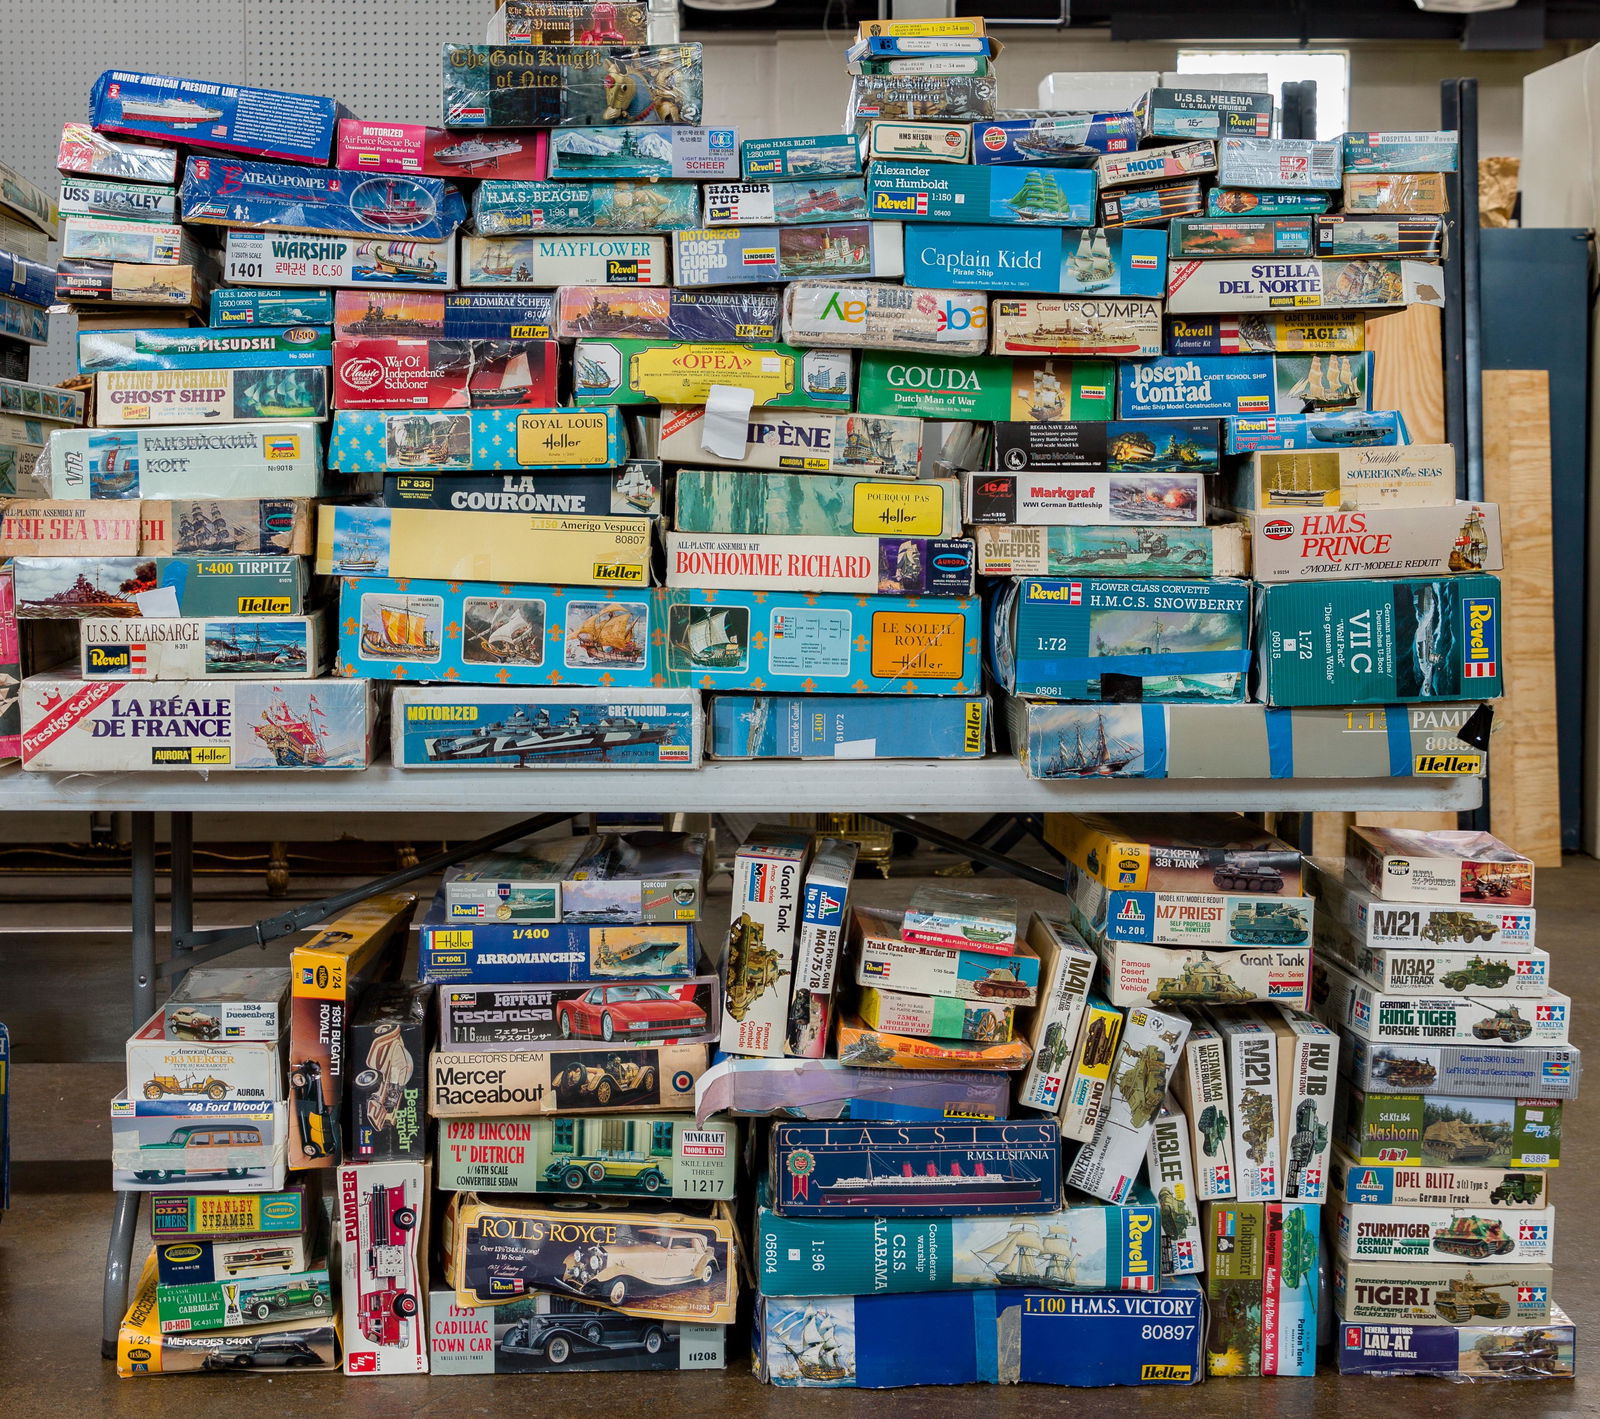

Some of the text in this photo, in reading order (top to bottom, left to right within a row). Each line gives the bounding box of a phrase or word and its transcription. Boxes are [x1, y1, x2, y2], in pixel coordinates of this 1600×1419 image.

[449, 49, 601, 69] The Gold Knight
[112, 72, 238, 98] NAVIRE AMERICAN PRESIDENT LINE
[1175, 94, 1252, 106] U.S.S. HELENA
[342, 136, 421, 147] Air Force Rescue Boat
[875, 165, 930, 177] Alexander
[709, 184, 770, 195] HARBOR
[875, 178, 949, 191] von Humboldt
[63, 188, 162, 209] USS BUCKLEY
[709, 195, 740, 205] TUG
[680, 230, 740, 241] MOTORIZED
[272, 241, 347, 260] WARSHIP
[539, 242, 650, 257] MAYFLOWER
[680, 241, 724, 255] COAST
[681, 255, 728, 269] GUARD
[921, 247, 1042, 272] Captain Kidd
[230, 263, 262, 277] 1401
[682, 270, 709, 284] TUG
[1251, 265, 1319, 279] STELLA
[66, 277, 101, 286] Repulse
[1219, 279, 1321, 294] DEL NORTE
[1082, 303, 1158, 318] OLYMPIA
[290, 329, 314, 340] 1/500
[385, 356, 419, 367] War Of
[107, 371, 228, 389] FLYING DUTCHMAN
[385, 368, 444, 378] Independence
[887, 365, 981, 389] GOUDA
[1132, 363, 1201, 383] Joseph
[385, 379, 428, 389] Schooner
[110, 390, 226, 404] GHOST SHIP
[894, 394, 976, 405] Dutch Man of War
[1135, 383, 1212, 402] Conrad
[522, 419, 603, 429] ROYAL LOUIS
[503, 476, 535, 492] LA
[1031, 487, 1095, 498] Markgraf
[451, 492, 585, 512] COURONNE
[1068, 501, 1102, 509] Battleship
[560, 521, 645, 532] Amerigo Vespucci
[615, 536, 645, 544] 80807
[678, 542, 715, 550] ALL-PLASTIC
[238, 561, 291, 574] TIRPITZ
[676, 552, 871, 578] BONHOMME RICHARD
[1091, 583, 1209, 595] FLOWER CLASS CORVETTE
[1091, 596, 1244, 610] H.M.C.S. SNOWBERRY
[86, 622, 200, 642] U.S.S. KEARSARGE
[1038, 638, 1066, 650] 1:72
[1036, 687, 1062, 695] 05061
[112, 695, 231, 717] LA RÉALE
[608, 705, 666, 717] GREYHOUND
[92, 720, 231, 737] DE FRANCE
[777, 866, 795, 932] Grant Tank
[1374, 911, 1420, 936] M21
[513, 929, 549, 939] 1/400
[477, 952, 585, 964] ARROMANCHES
[1121, 960, 1150, 968] Famous
[1391, 959, 1435, 975] M3A2
[1121, 976, 1149, 984] Combat
[1391, 976, 1434, 985] HALF TRACK
[320, 1004, 330, 1044] ROYALE
[1379, 1009, 1456, 1026] KING TIGER
[1379, 1026, 1456, 1036] PORSCHE TURRET
[331, 1005, 341, 1075] 1931 BUGATTI
[436, 1068, 506, 1085] Mercer
[436, 1084, 543, 1105] Raceabout
[188, 1102, 269, 1113] '48 Ford Woody
[684, 1133, 724, 1143] MINICRAFT
[1369, 1124, 1419, 1141] Nashorn
[967, 1150, 1049, 1161] R.M.S. LUSITANIA
[457, 1177, 517, 1187] CONVERTIBLE SEDAN
[684, 1180, 723, 1193] 11217
[1395, 1172, 1454, 1189] OPEL BLITZ
[202, 1200, 253, 1213] STANLEY
[343, 1171, 358, 1242] PUMPER
[202, 1213, 253, 1226] STEAMER
[482, 1218, 617, 1243] ROLLS-ROYCE
[1358, 1223, 1429, 1237] STURMTIGER
[765, 1233, 777, 1273] 05604
[1357, 1246, 1429, 1255] ASSAULT MORTAR
[1025, 1298, 1193, 1314] 1.100 H.M.S. VICTORY
[435, 1320, 488, 1335] CADILLAC
[1142, 1325, 1194, 1339] 80897
[432, 1338, 491, 1353] TOWN CAR
[1364, 1335, 1411, 1350] LAV-AT
